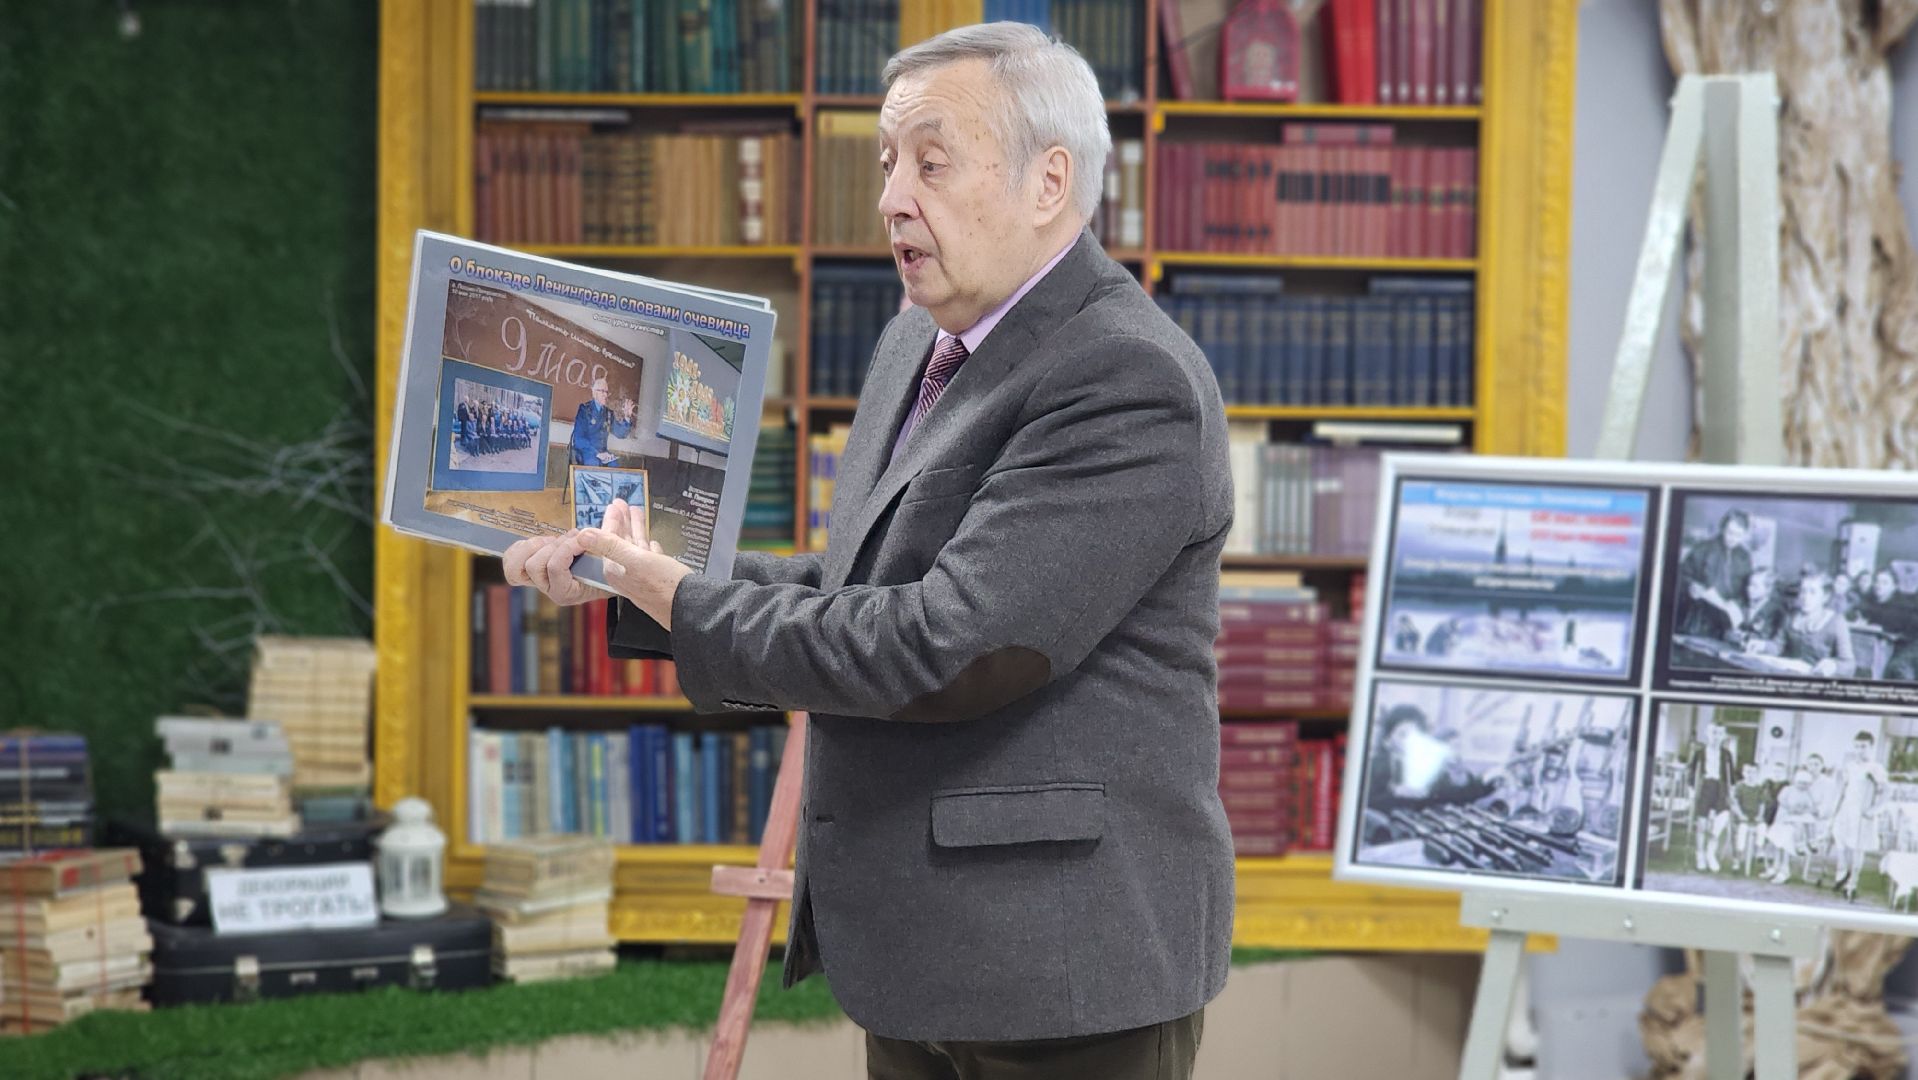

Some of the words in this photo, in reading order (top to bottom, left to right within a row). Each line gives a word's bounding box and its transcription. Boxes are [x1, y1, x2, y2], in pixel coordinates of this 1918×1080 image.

[450, 256, 463, 273] О
[466, 259, 531, 290] блокаде
[535, 275, 617, 309] Ленинграда
[619, 296, 680, 321] словами
[683, 310, 750, 339] очевидца
[501, 316, 527, 371] 9
[219, 902, 248, 921] НЕ
